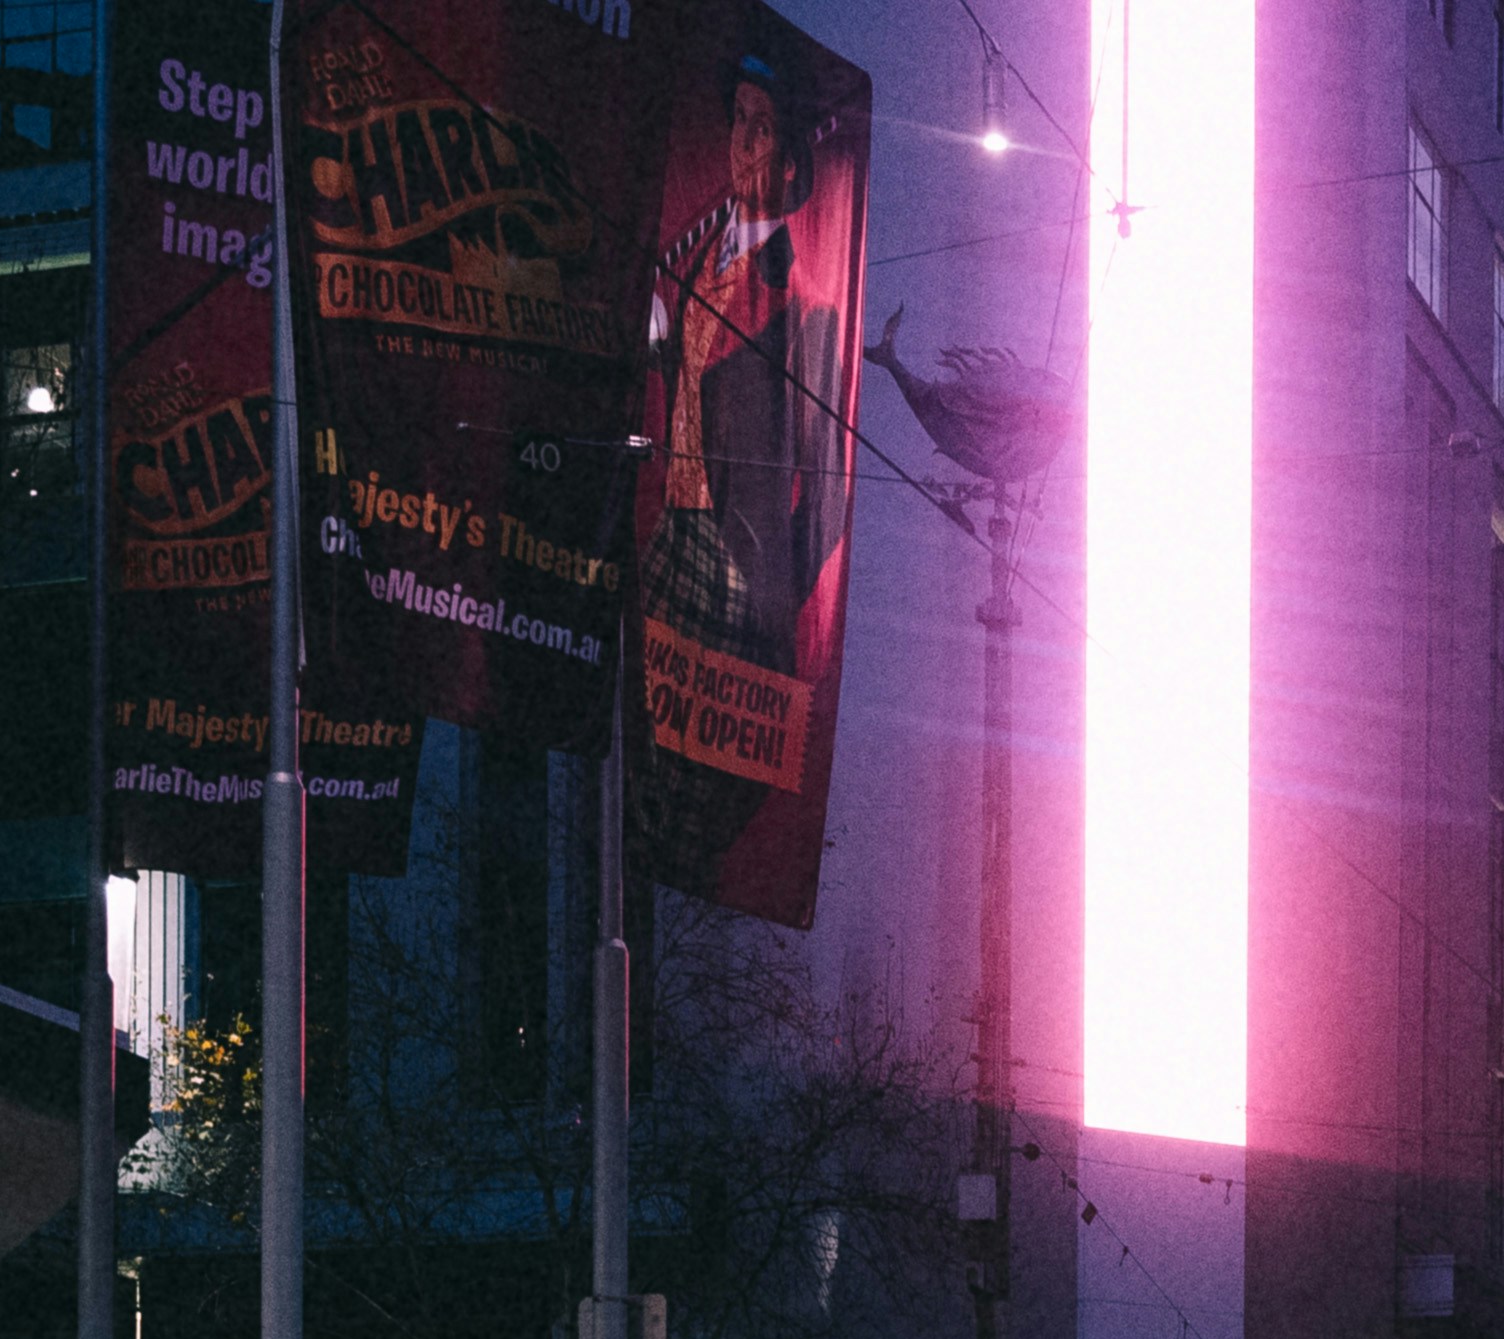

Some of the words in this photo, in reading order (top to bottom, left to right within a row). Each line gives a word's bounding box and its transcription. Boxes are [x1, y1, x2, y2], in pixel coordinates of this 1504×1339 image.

[158, 58, 263, 141] Step
[147, 138, 274, 204] world
[328, 260, 496, 332] CHOCOLATE
[506, 292, 616, 348] FACTORY
[375, 333, 411, 356] THE
[519, 442, 562, 473] 40
[351, 470, 486, 551] ajesty's
[498, 512, 620, 592] Theatre
[695, 662, 793, 725] FACTORY
[301, 707, 412, 747] Theatre
[698, 706, 787, 771] OPEN!
